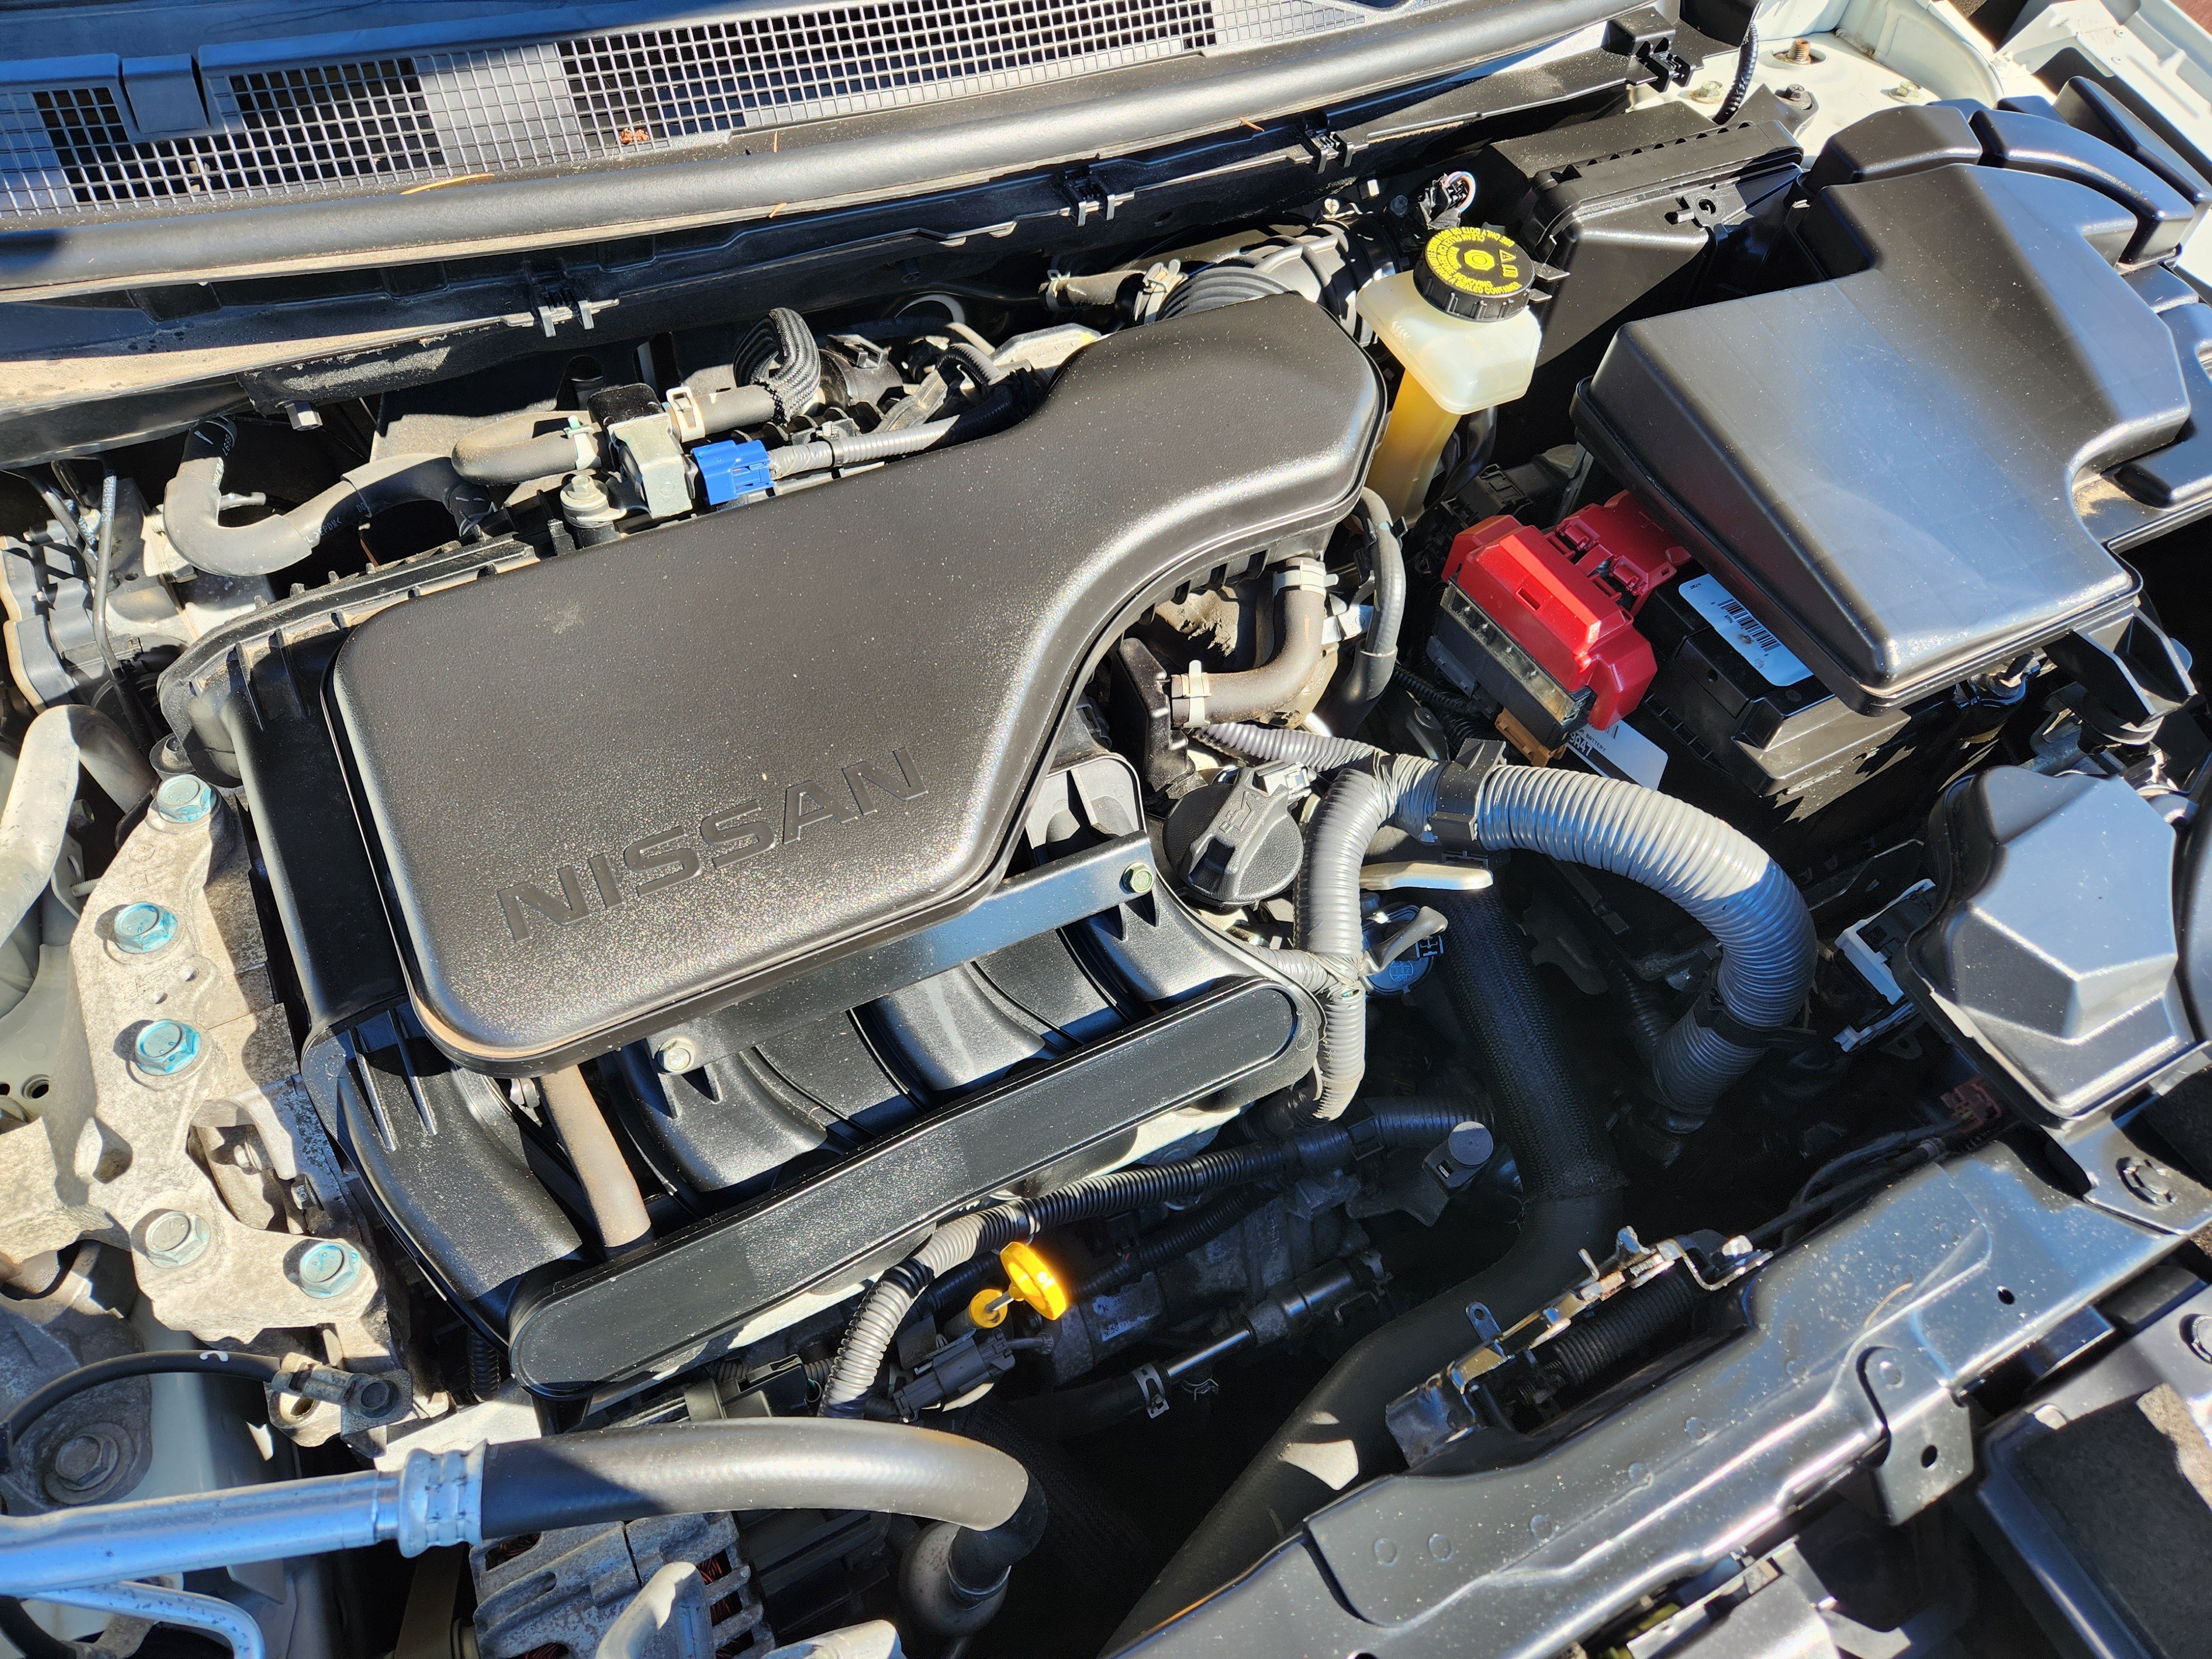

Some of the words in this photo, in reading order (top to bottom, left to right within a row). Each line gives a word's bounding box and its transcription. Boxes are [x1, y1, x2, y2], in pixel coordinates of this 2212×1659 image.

[1461, 234, 1485, 242] CLEAN
[1481, 229, 1501, 241] ONLY
[1499, 236, 1515, 247] USE
[1453, 272, 1493, 288] REMOVING
[1454, 281, 1483, 294] SEALED
[1484, 281, 1522, 294] CONTAINER
[1586, 734, 1606, 752] BATTERY
[497, 747, 929, 943] NISSAN
